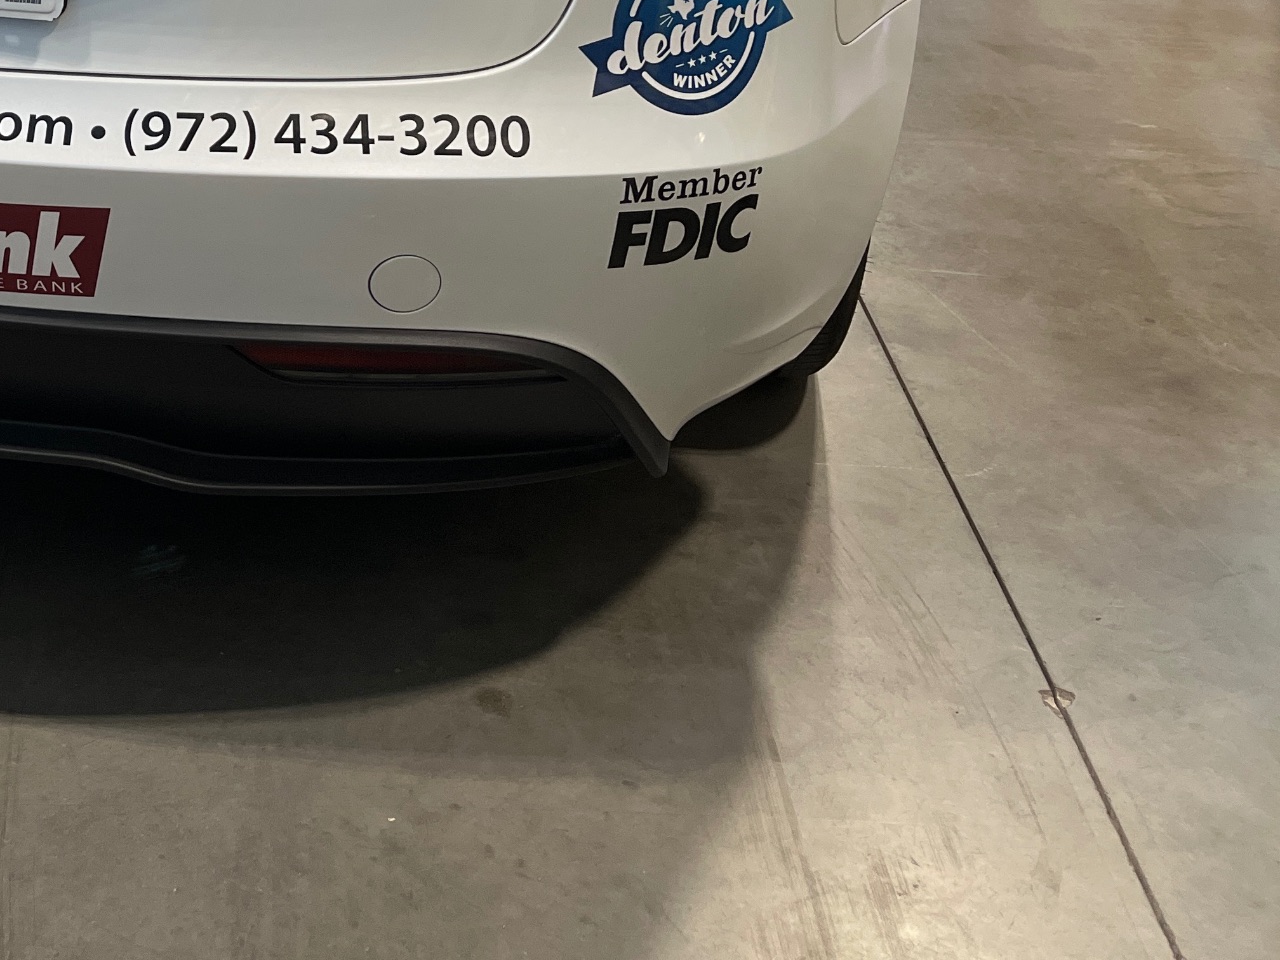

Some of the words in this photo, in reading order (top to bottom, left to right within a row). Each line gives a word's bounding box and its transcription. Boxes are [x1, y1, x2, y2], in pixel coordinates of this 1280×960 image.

[672, 53, 738, 89] WINNER
[123, 107, 257, 160] (972)
[273, 111, 532, 158] 434-3200
[619, 165, 764, 205] Member
[606, 193, 760, 270] FDIC
[16, 279, 84, 294] BANK
